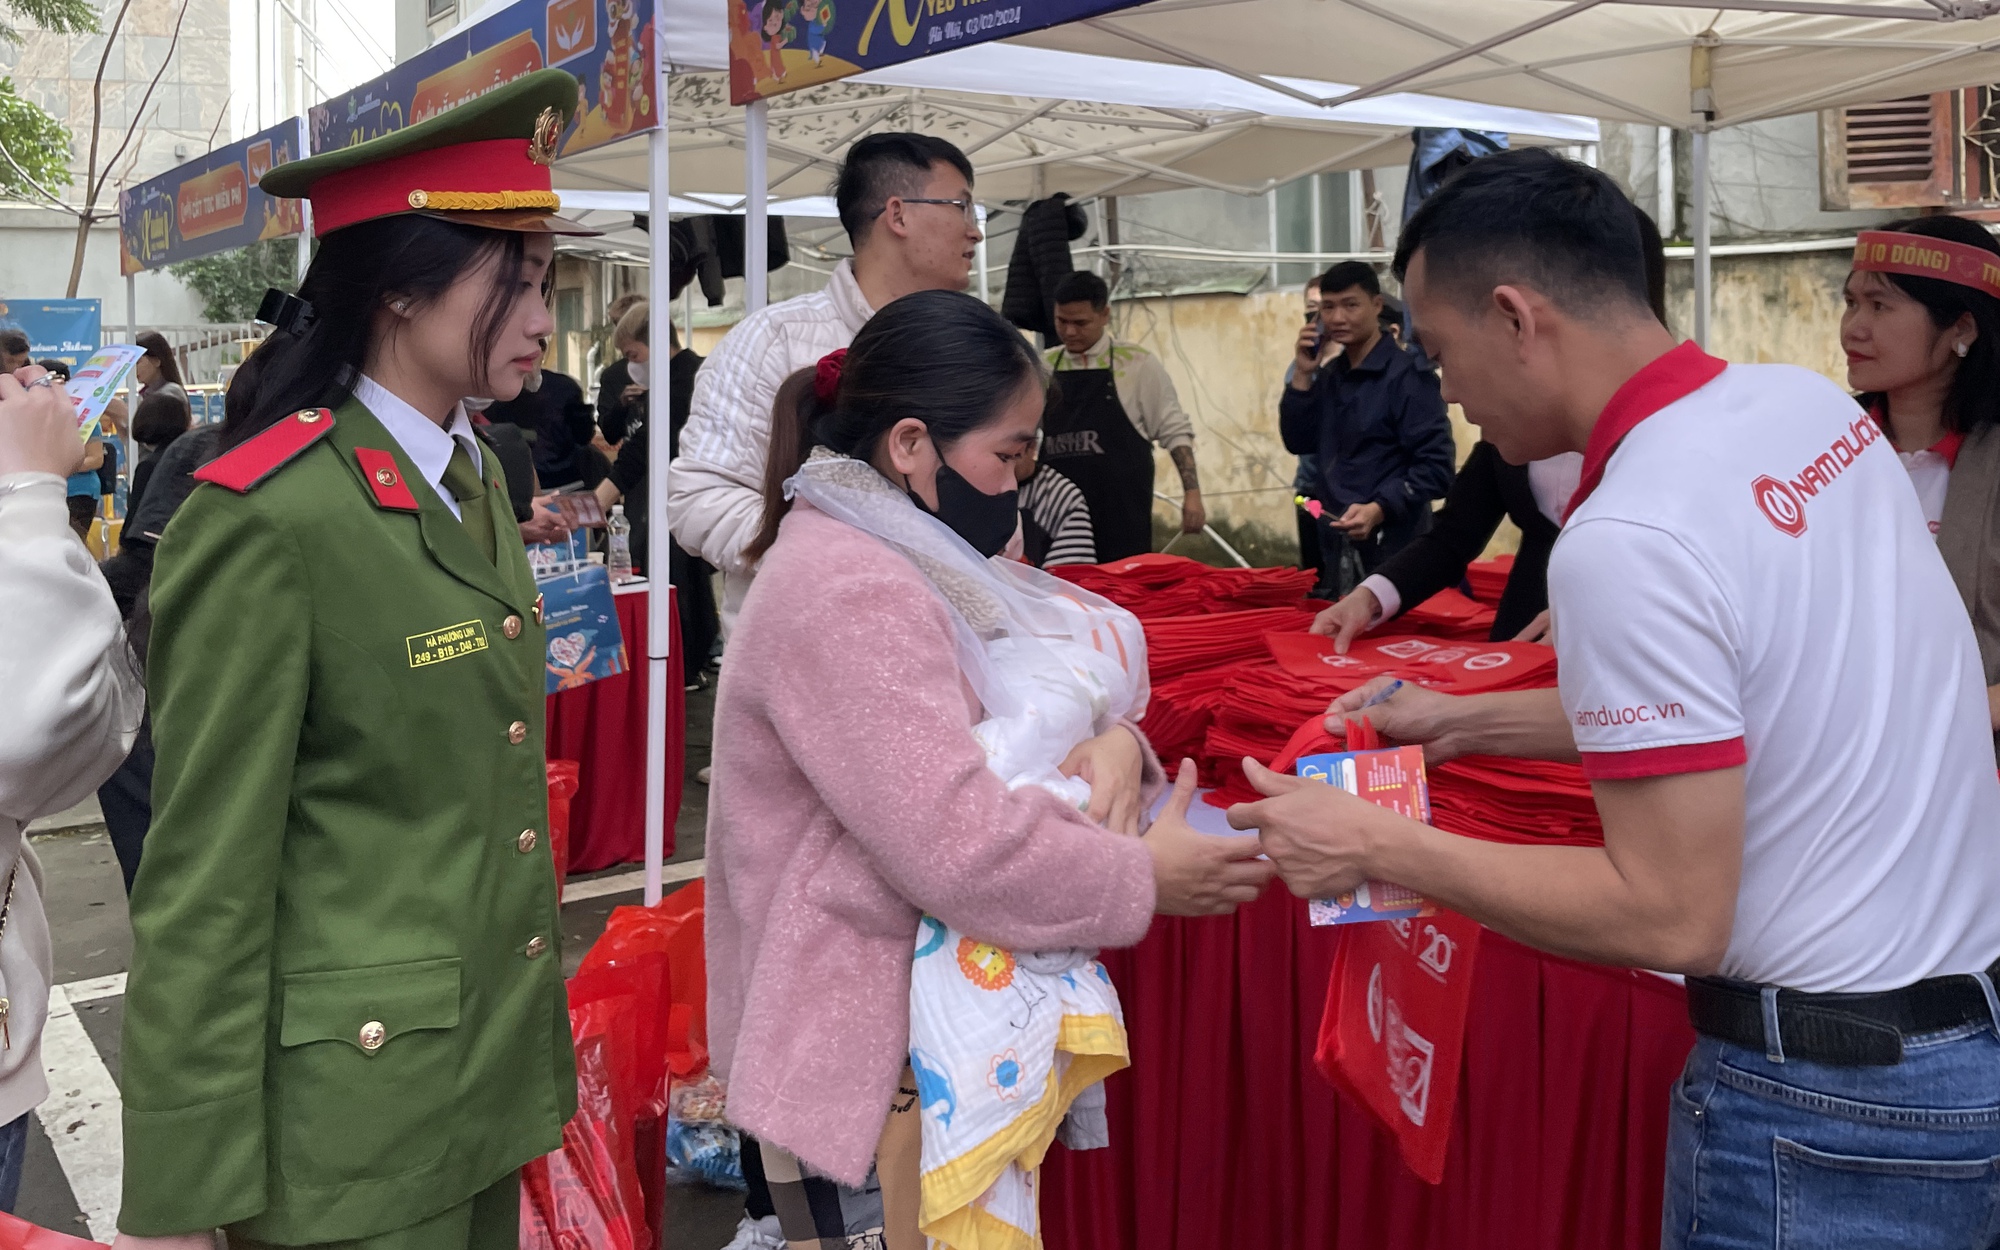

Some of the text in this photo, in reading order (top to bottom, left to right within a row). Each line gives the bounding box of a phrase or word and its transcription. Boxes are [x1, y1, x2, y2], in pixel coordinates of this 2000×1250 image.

[928, 24, 943, 45] Hà
[965, 6, 1022, 35] 03/02/2024
[1789, 452, 1842, 503] NAM
[426, 627, 475, 648] HÀ PHƯƠNG LINH
[415, 651, 431, 664] 249
[438, 646, 454, 658] B1B
[1576, 702, 1686, 727] amduoc.vn
